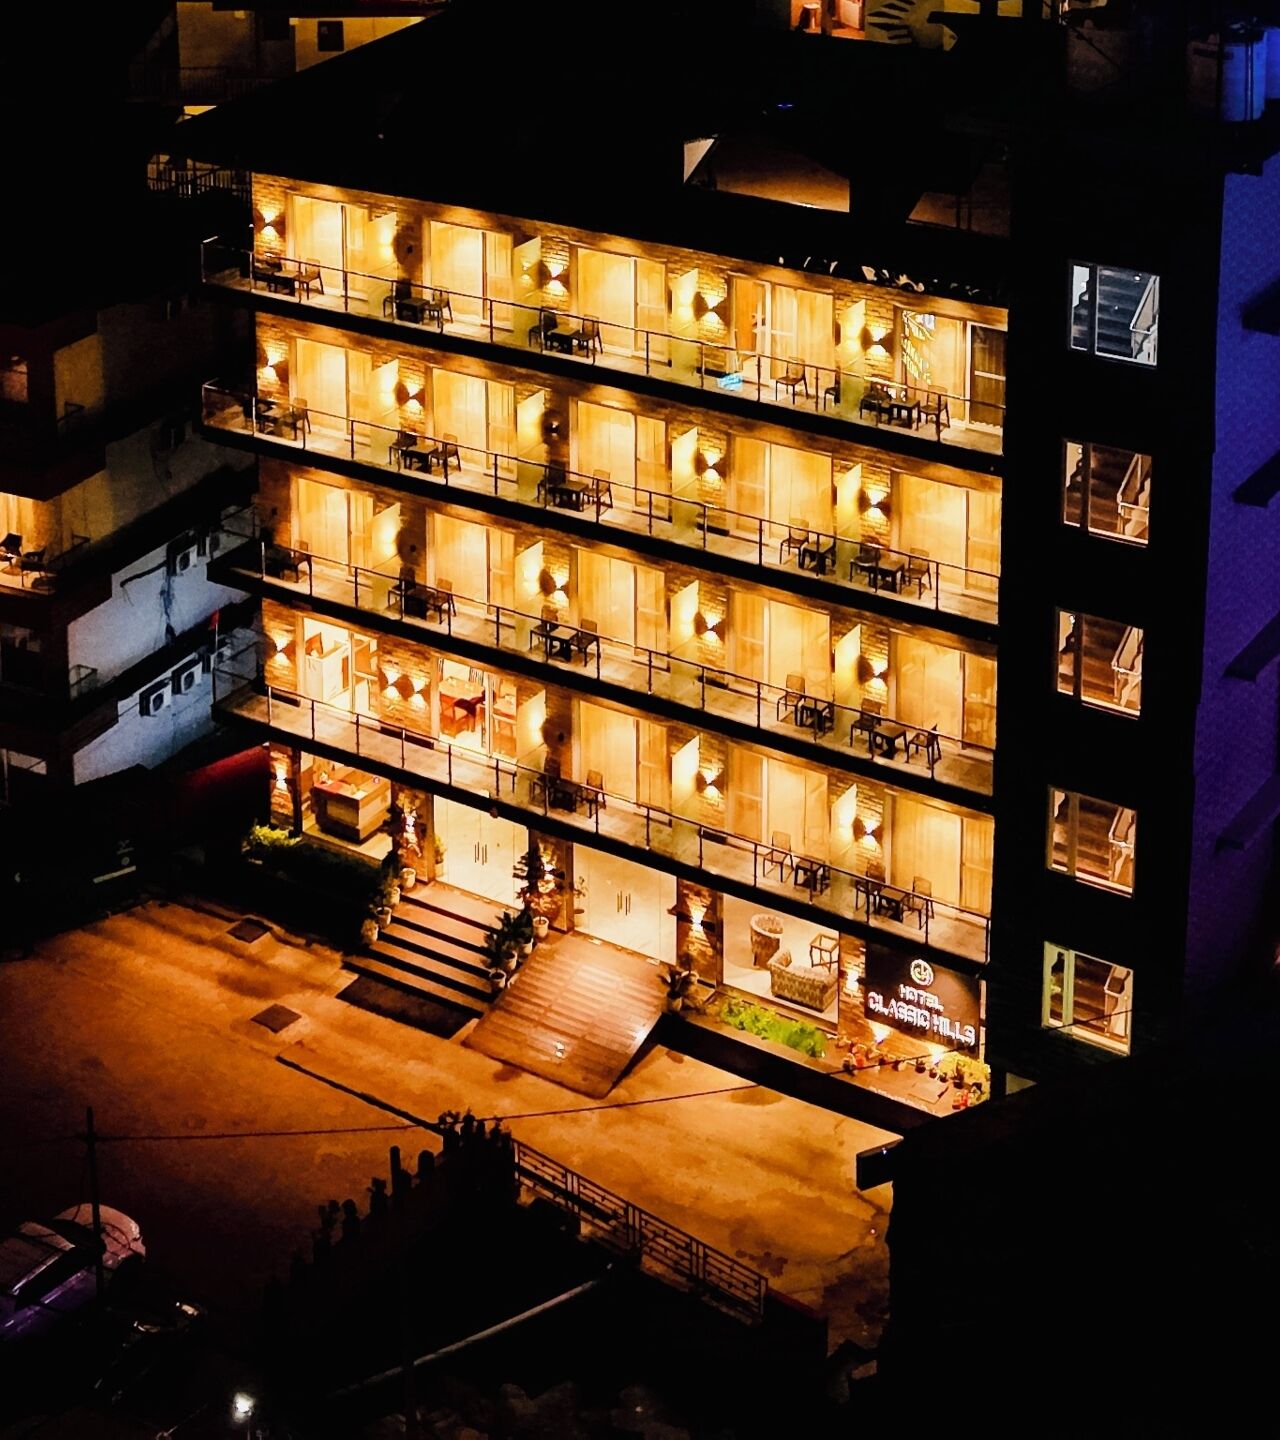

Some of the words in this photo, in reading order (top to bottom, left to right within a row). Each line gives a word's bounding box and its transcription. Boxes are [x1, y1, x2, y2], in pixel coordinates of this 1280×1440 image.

[867, 990, 931, 1031] CLASSIC
[931, 1012, 976, 1047] HILLS
[898, 983, 944, 1013] HOTEL
